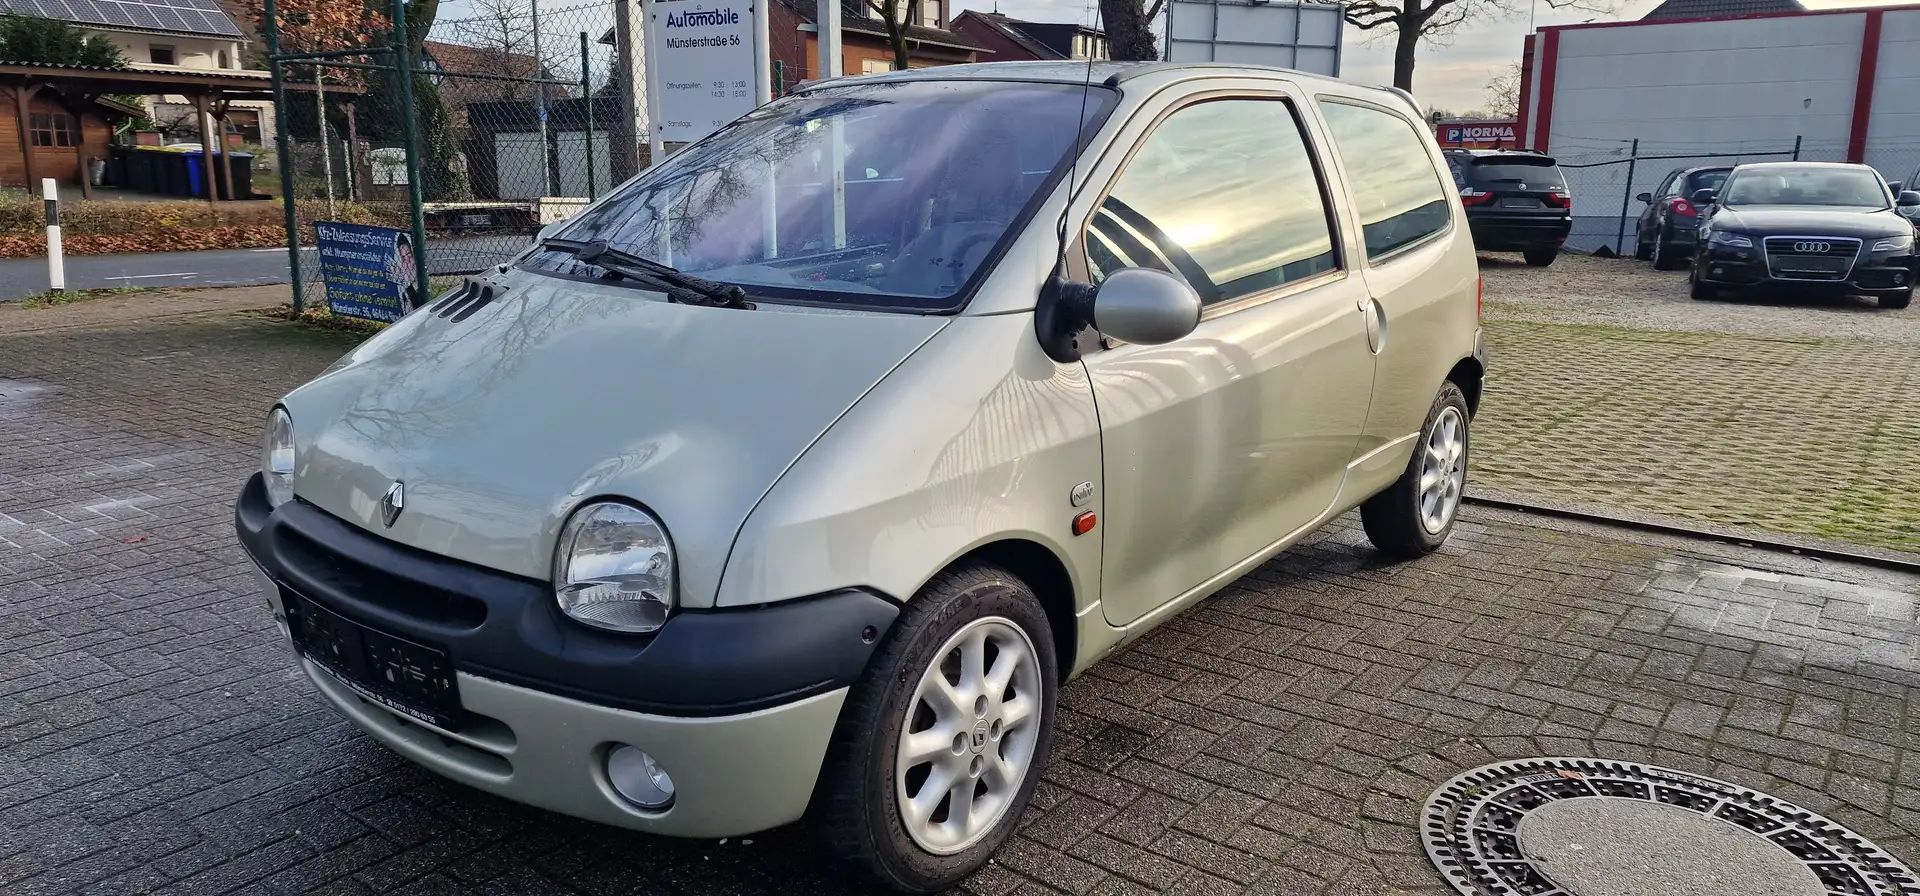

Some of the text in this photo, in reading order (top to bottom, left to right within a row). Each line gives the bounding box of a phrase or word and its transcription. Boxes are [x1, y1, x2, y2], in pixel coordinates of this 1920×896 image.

[666, 7, 739, 28] Automobile
[666, 34, 741, 49] Münsterstraße 56
[731, 80, 746, 88] 13:00
[711, 90, 725, 98] 14:30
[732, 90, 746, 98] 18:00
[1462, 126, 1514, 137] NORMA
